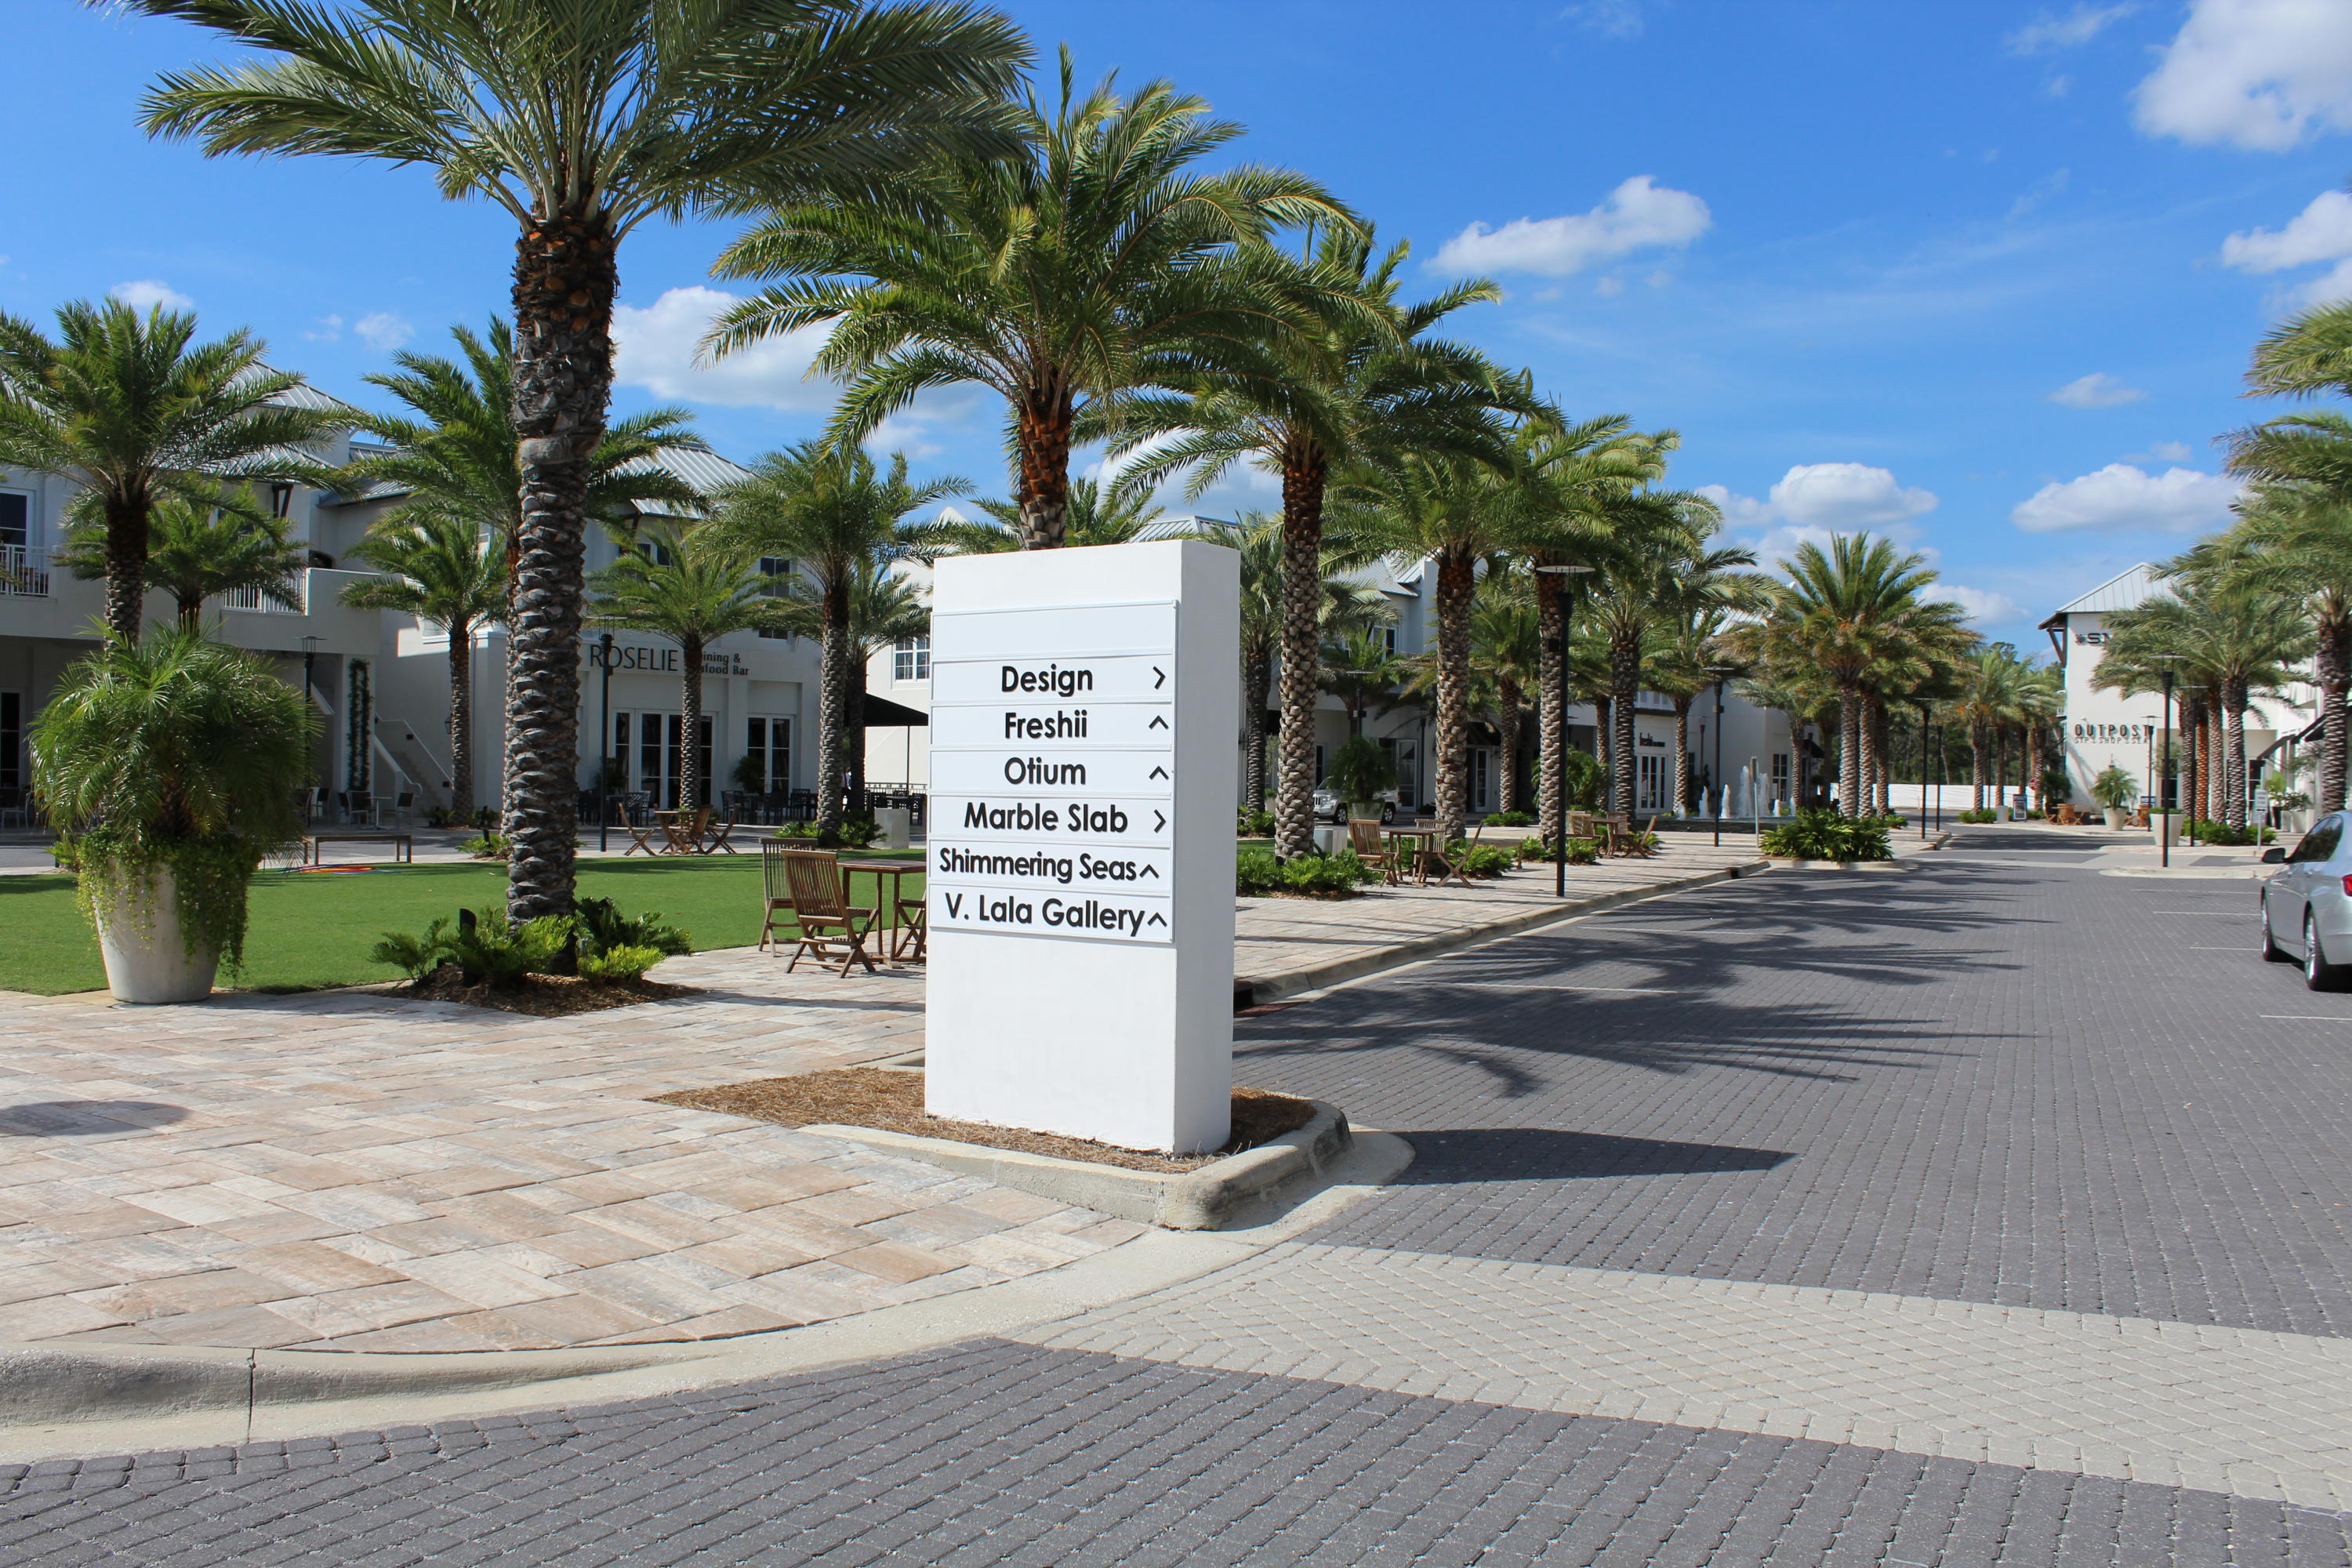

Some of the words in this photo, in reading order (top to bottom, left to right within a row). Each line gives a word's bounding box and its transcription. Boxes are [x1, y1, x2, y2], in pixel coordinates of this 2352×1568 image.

[590, 644, 678, 671] ROSELIE
[702, 651, 729, 666] ining
[733, 653, 741, 663] &
[733, 665, 750, 675] Bar
[1001, 663, 1093, 697] Design
[1005, 709, 1087, 739] Freshii
[2074, 724, 2150, 737] OUTPOST
[1004, 757, 1086, 785] Otium
[964, 802, 1059, 831] Marble
[1067, 804, 1128, 833] Slab
[939, 848, 1073, 884] Shimmering
[1079, 853, 1137, 880] Seas
[945, 892, 969, 920] V.
[979, 895, 1033, 924] Lala
[1042, 898, 1145, 937] Gallery
